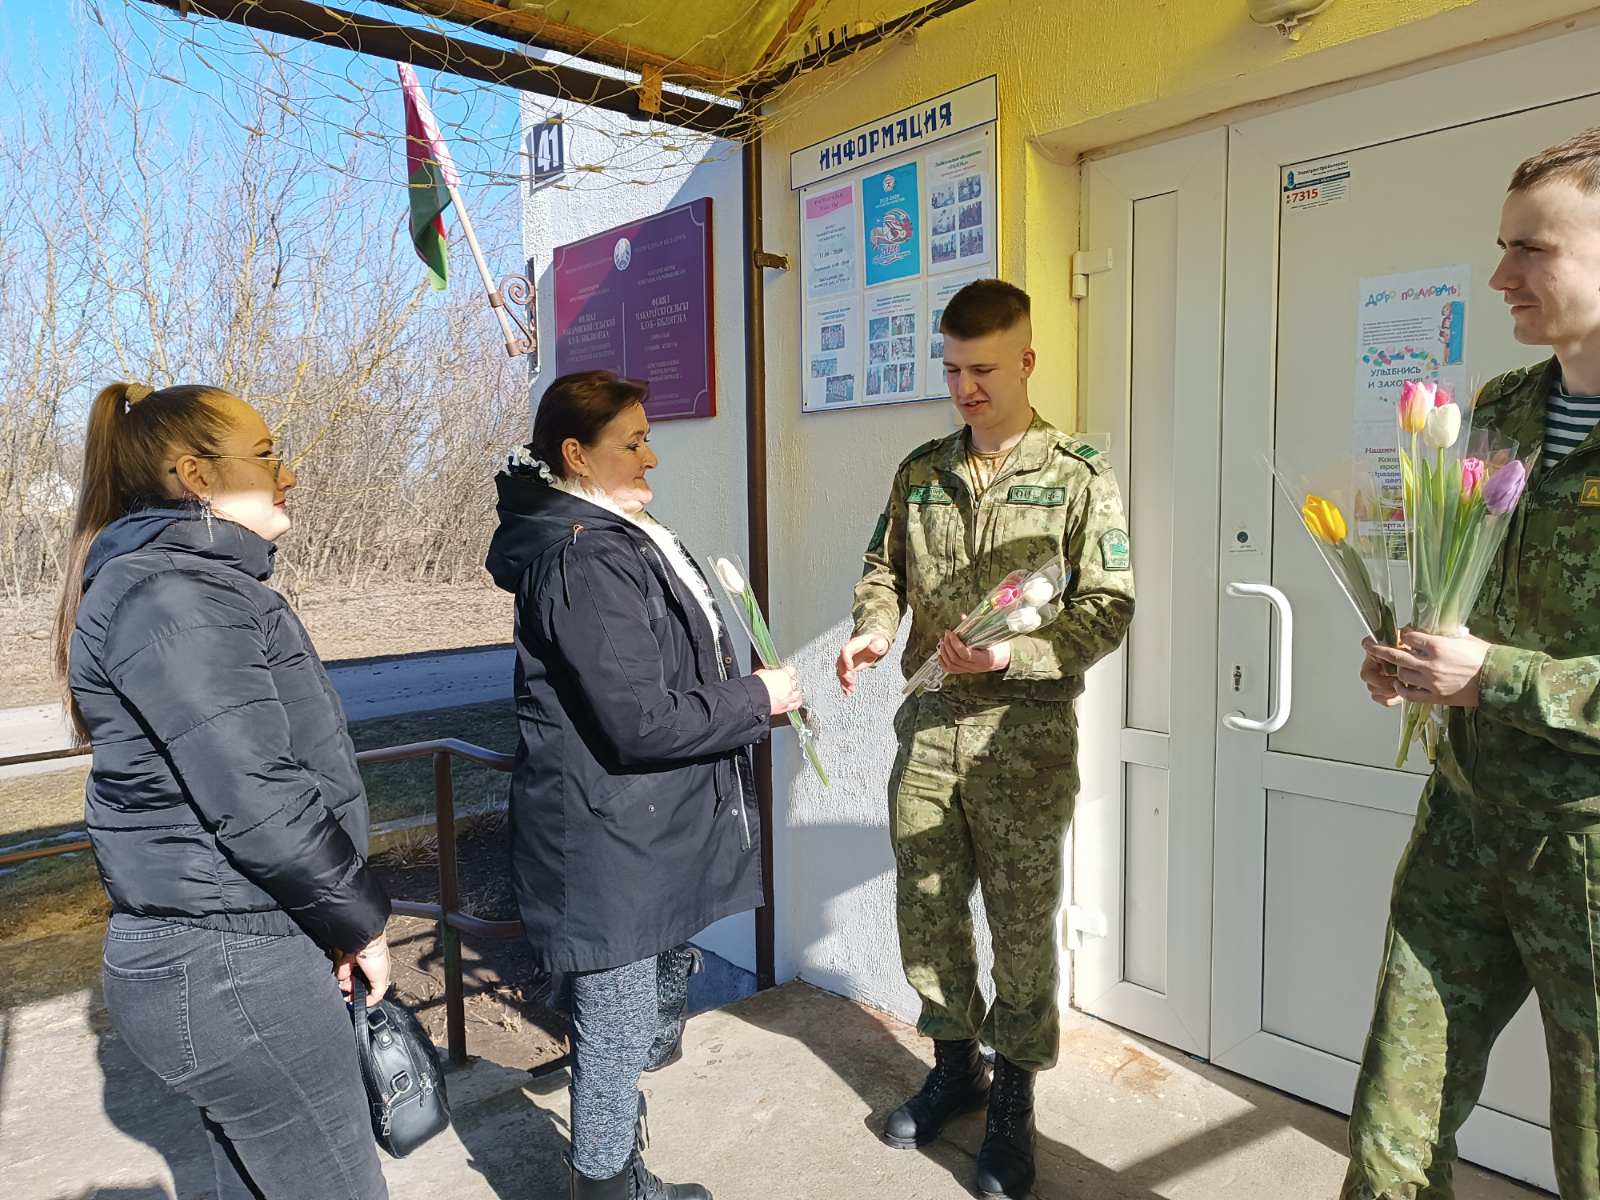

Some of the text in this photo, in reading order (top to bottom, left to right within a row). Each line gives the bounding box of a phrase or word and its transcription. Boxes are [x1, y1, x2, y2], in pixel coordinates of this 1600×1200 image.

[537, 124, 560, 172] 41
[819, 101, 952, 171] ИНФОРМАЦИЯ
[1291, 188, 1319, 203] 7315
[1370, 366, 1422, 377] УЛЫБНИСЬ
